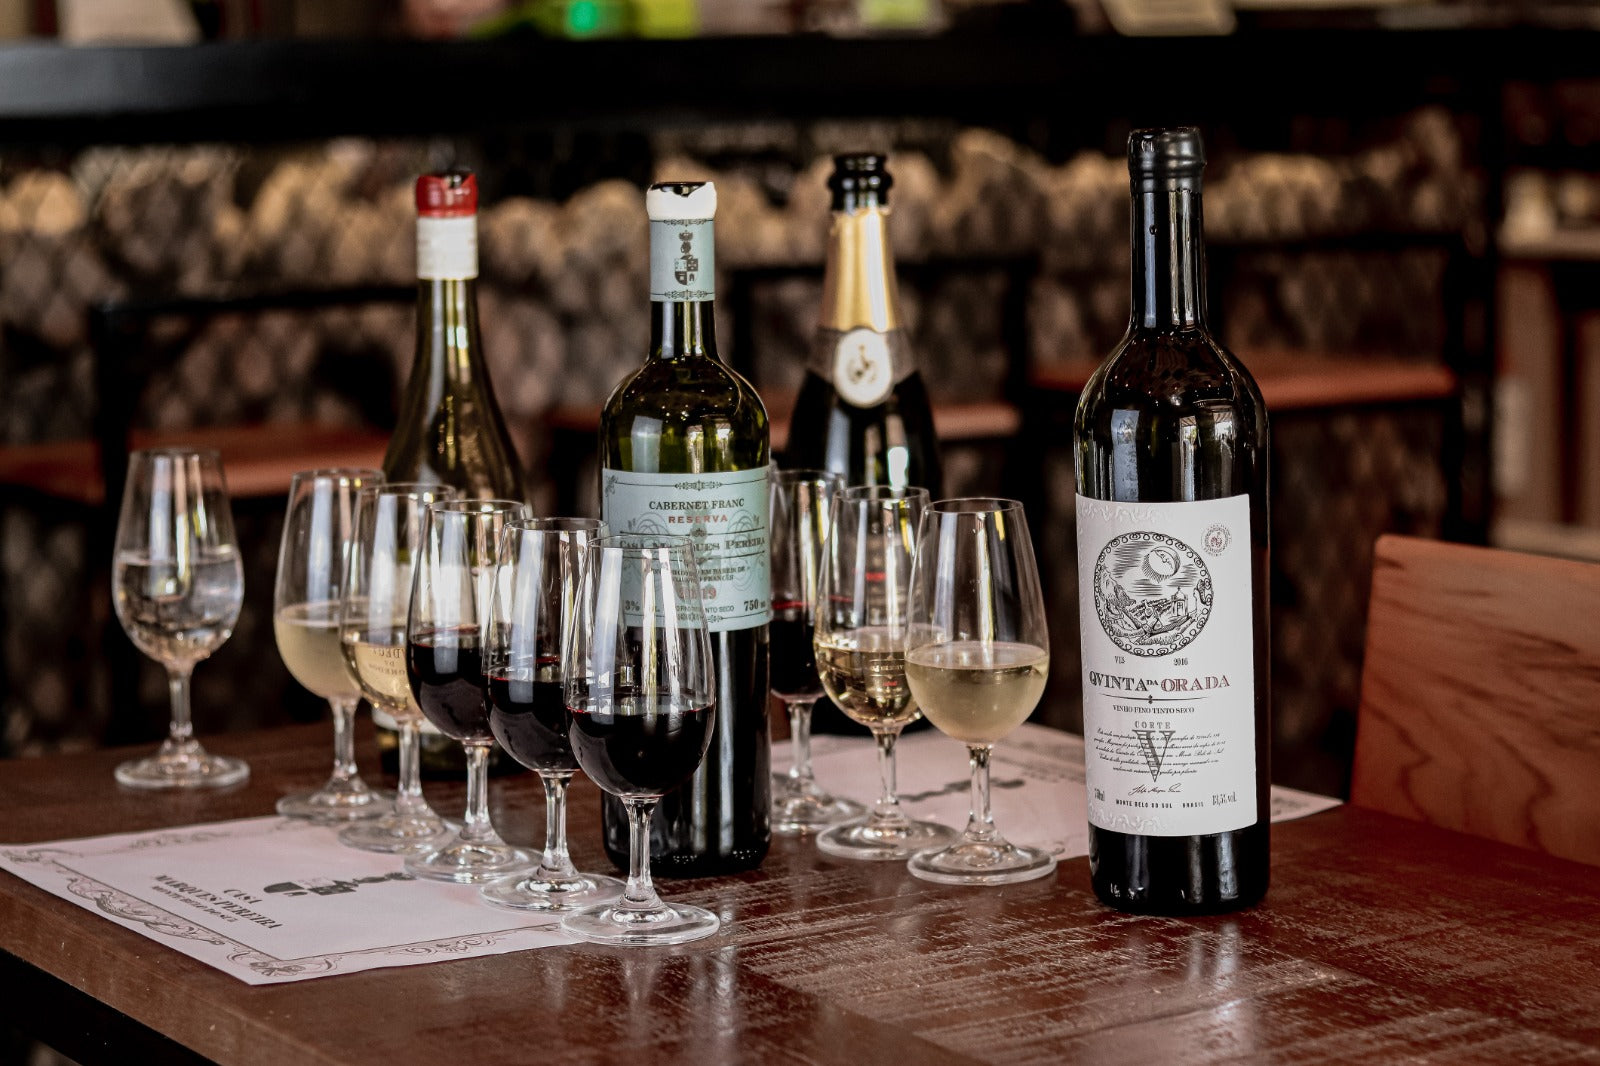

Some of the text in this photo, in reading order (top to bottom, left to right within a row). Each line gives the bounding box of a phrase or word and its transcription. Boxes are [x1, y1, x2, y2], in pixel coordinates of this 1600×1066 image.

[649, 498, 745, 511] CABERNET FRANC
[668, 514, 728, 524] RESERVA
[725, 537, 765, 550] PEREIRA
[719, 605, 735, 613] SECO
[743, 599, 759, 611] 750
[1089, 670, 1148, 692] QVINTA
[1161, 674, 1231, 693] ORADA
[1112, 704, 1133, 713] VINHO
[1134, 706, 1151, 714] FINO
[1176, 706, 1195, 714] SECO
[1134, 721, 1171, 729] CORTE
[212, 900, 283, 928] PEREIRA
